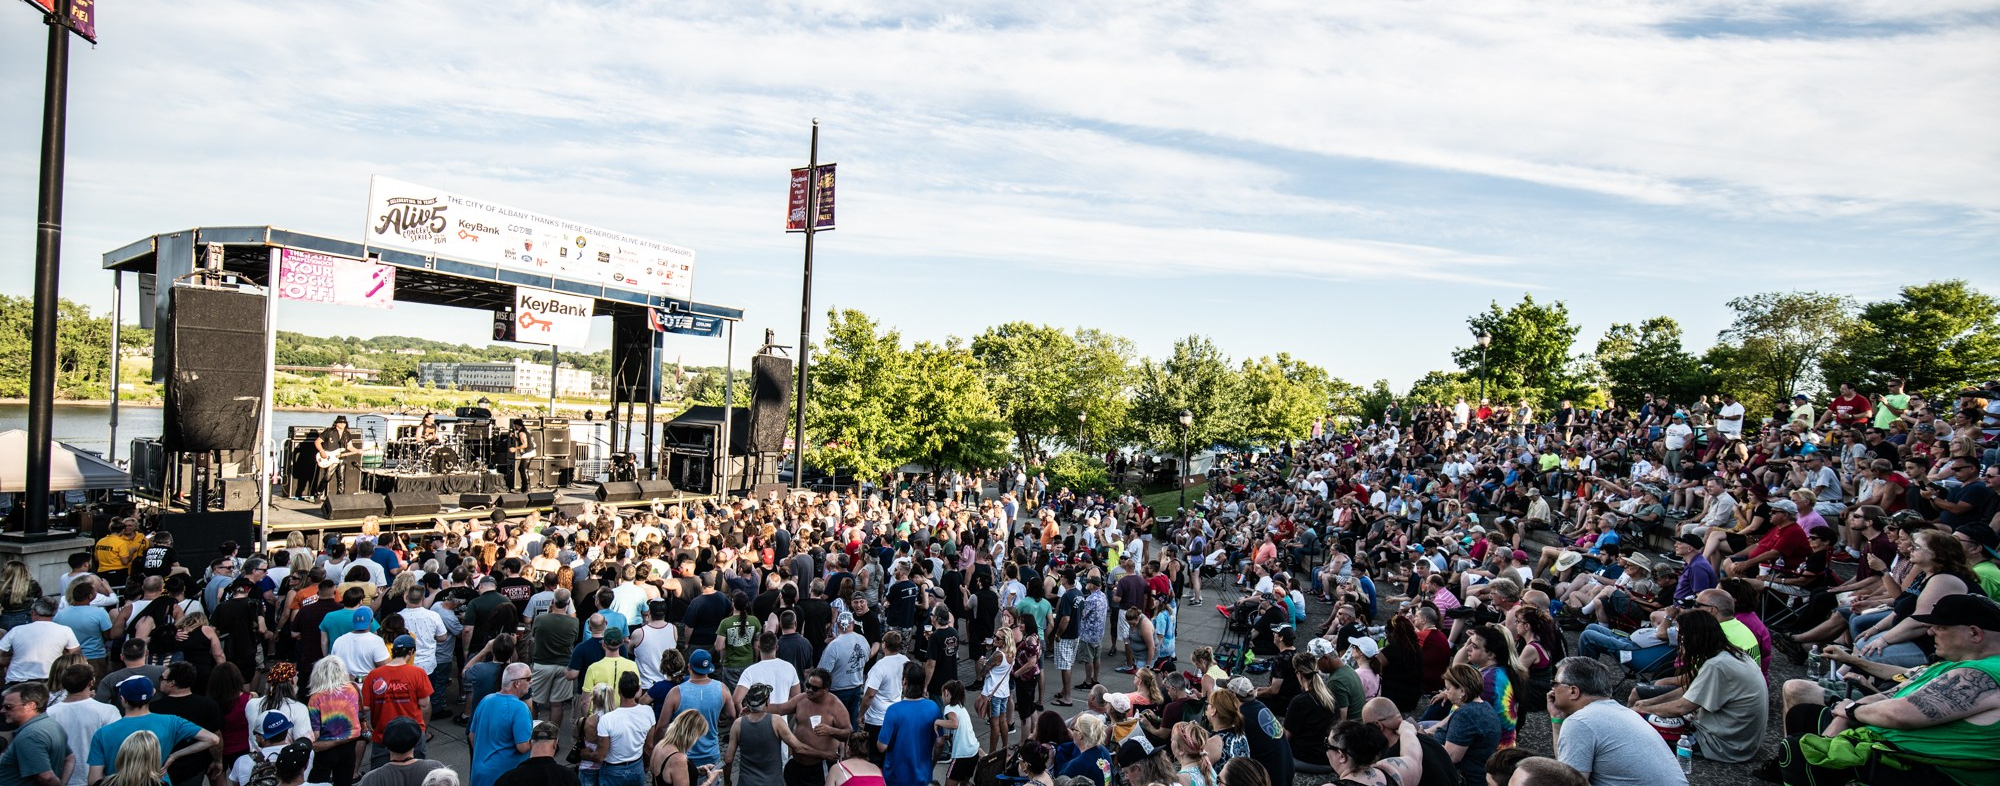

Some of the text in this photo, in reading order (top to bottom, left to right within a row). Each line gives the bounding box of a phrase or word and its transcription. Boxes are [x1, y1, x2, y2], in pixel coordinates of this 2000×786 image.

[403, 226, 429, 238] CONCERT
[448, 196, 463, 205] THE
[466, 200, 484, 209] CITY
[498, 208, 529, 221] ALBANY
[531, 215, 559, 227] THANKS
[562, 222, 582, 232] THESE
[585, 228, 619, 240] GENEROUS
[621, 236, 638, 245] ALIVE
[648, 242, 661, 250] FIVE
[662, 246, 692, 257] SPONSORS
[459, 219, 500, 236] KeyBank
[411, 232, 432, 242] SERIES
[288, 261, 333, 277] YOUR
[286, 272, 334, 287] SOCKS
[286, 284, 334, 302] OFF!
[520, 295, 586, 317] KeyBank
[496, 311, 508, 320] RISE
[388, 683, 408, 691] MAX
